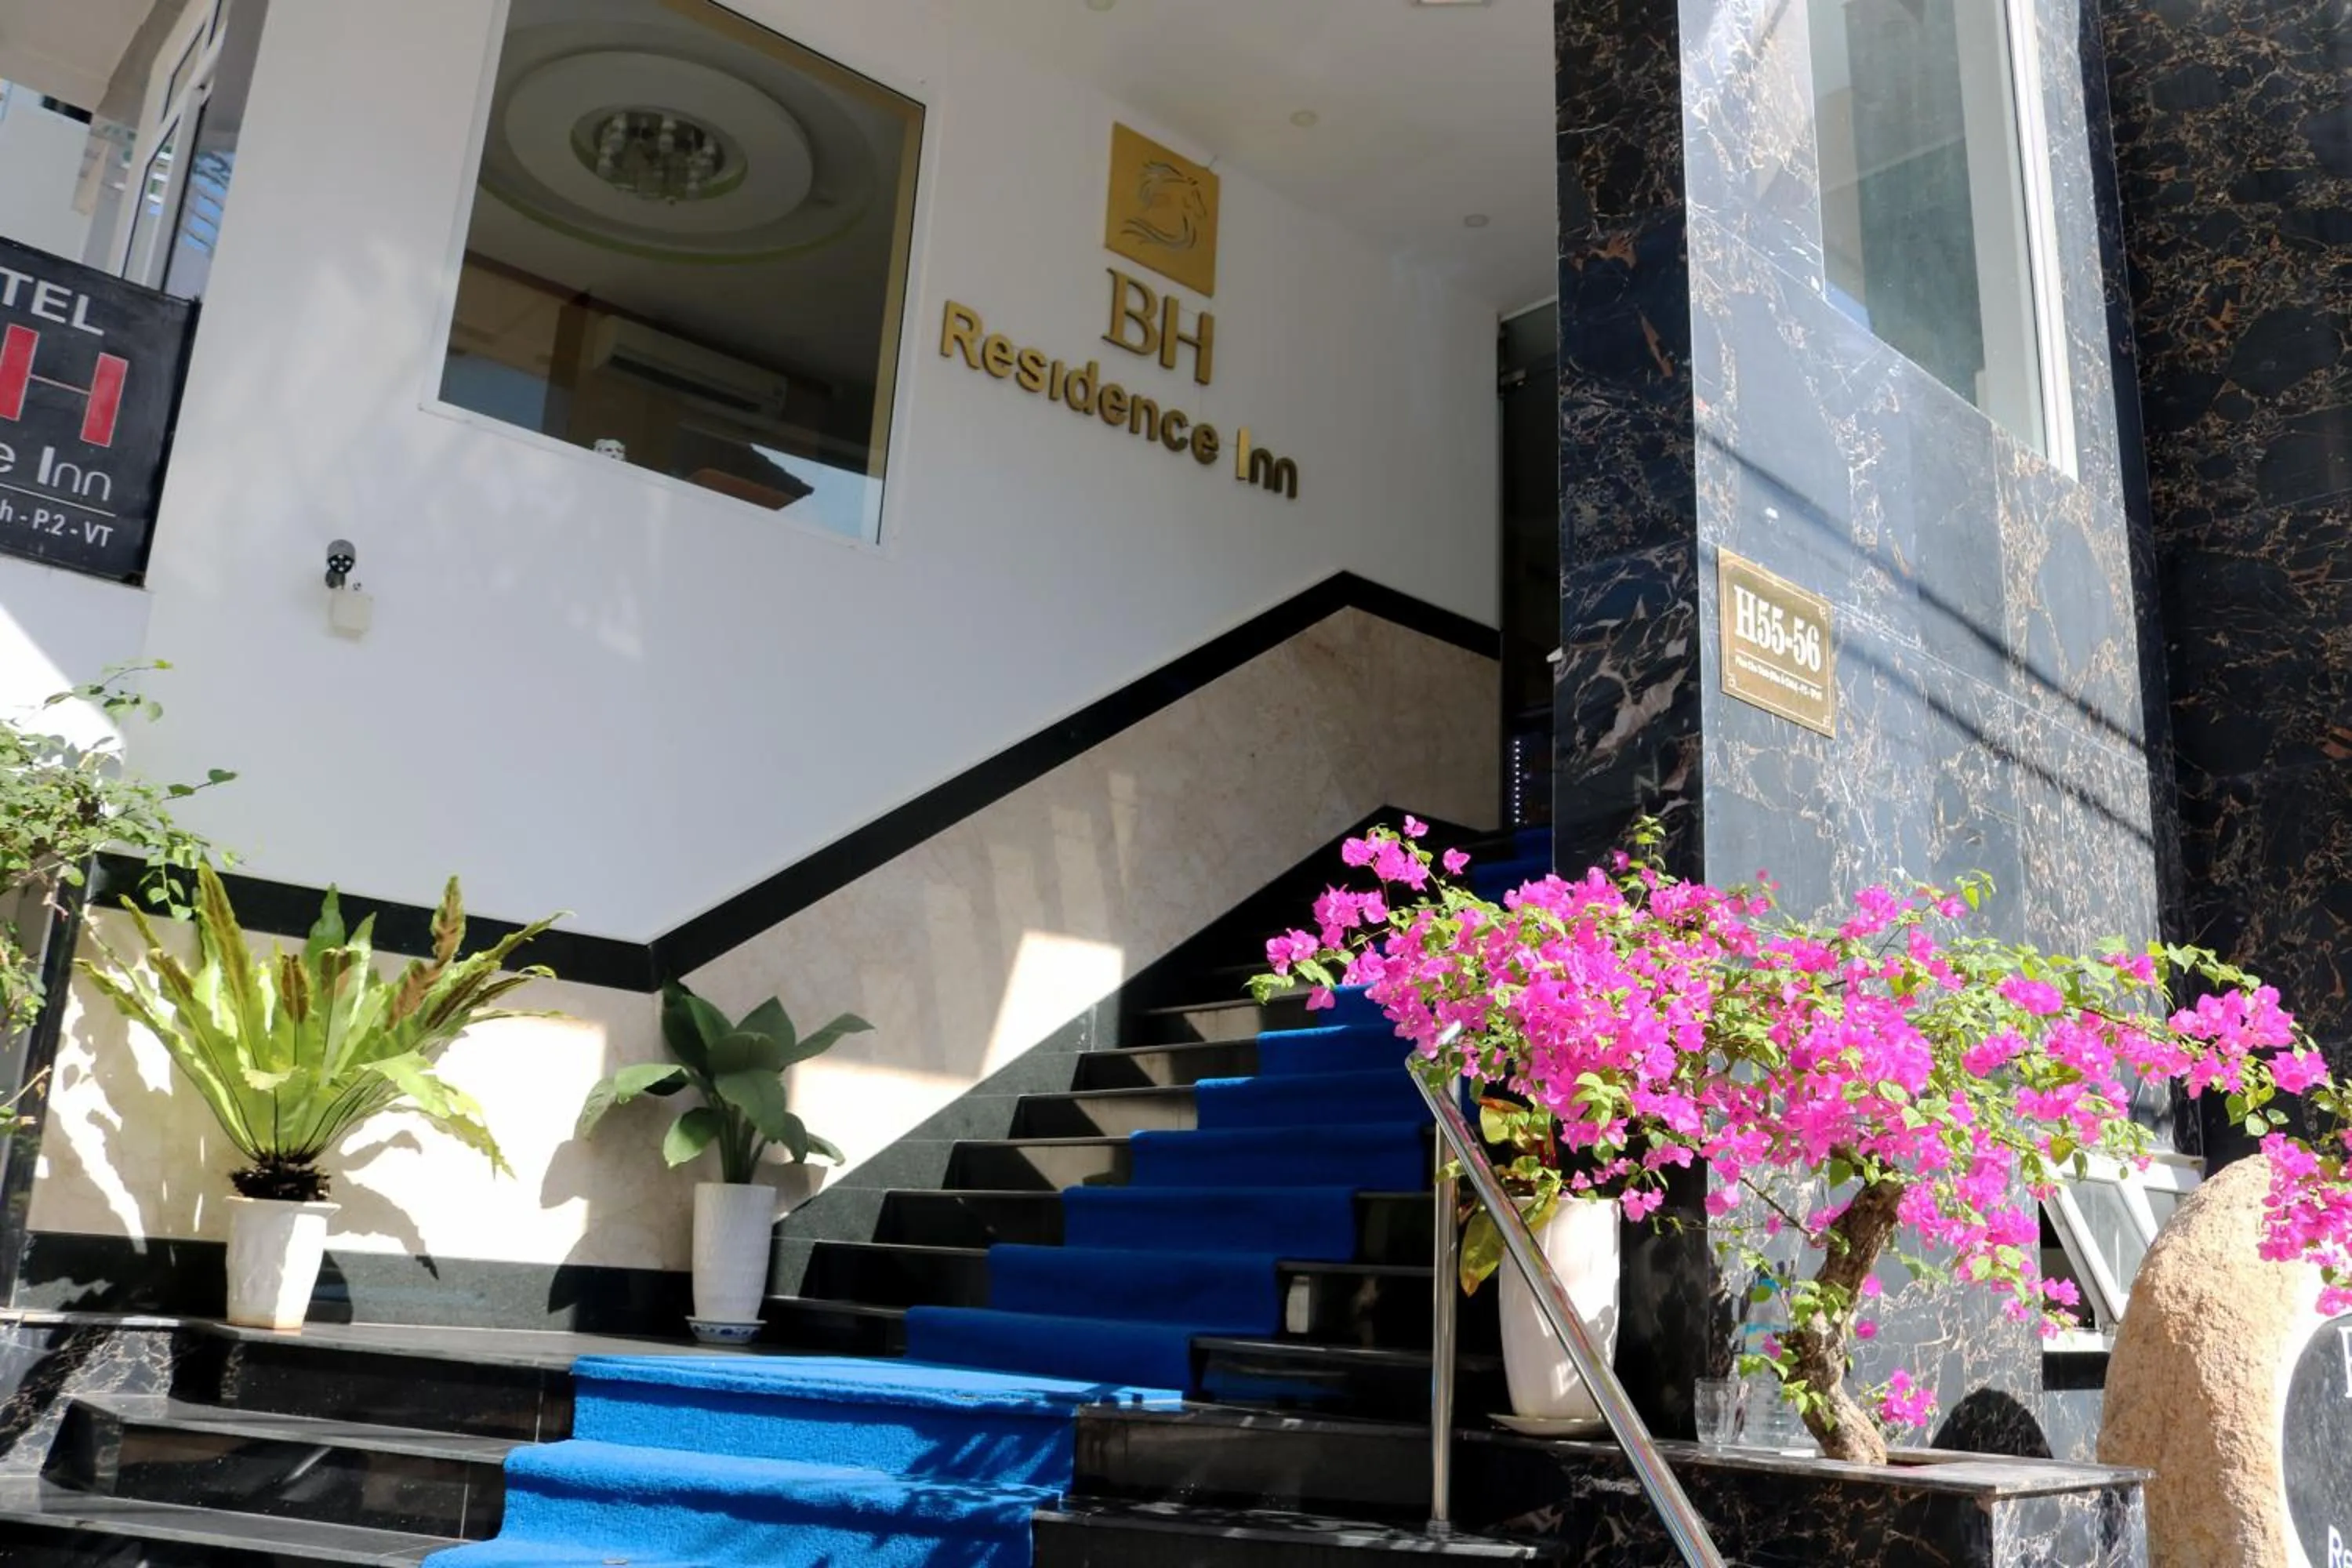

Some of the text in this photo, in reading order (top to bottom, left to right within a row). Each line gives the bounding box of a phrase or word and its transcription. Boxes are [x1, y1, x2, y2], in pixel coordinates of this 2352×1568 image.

[1102, 268, 1214, 385] BH
[940, 299, 1298, 499] Residence Inn
[37, 445, 111, 501] Inn
[32, 507, 65, 536] P.2
[84, 521, 114, 547] VT
[1734, 585, 1821, 673] H55-56
